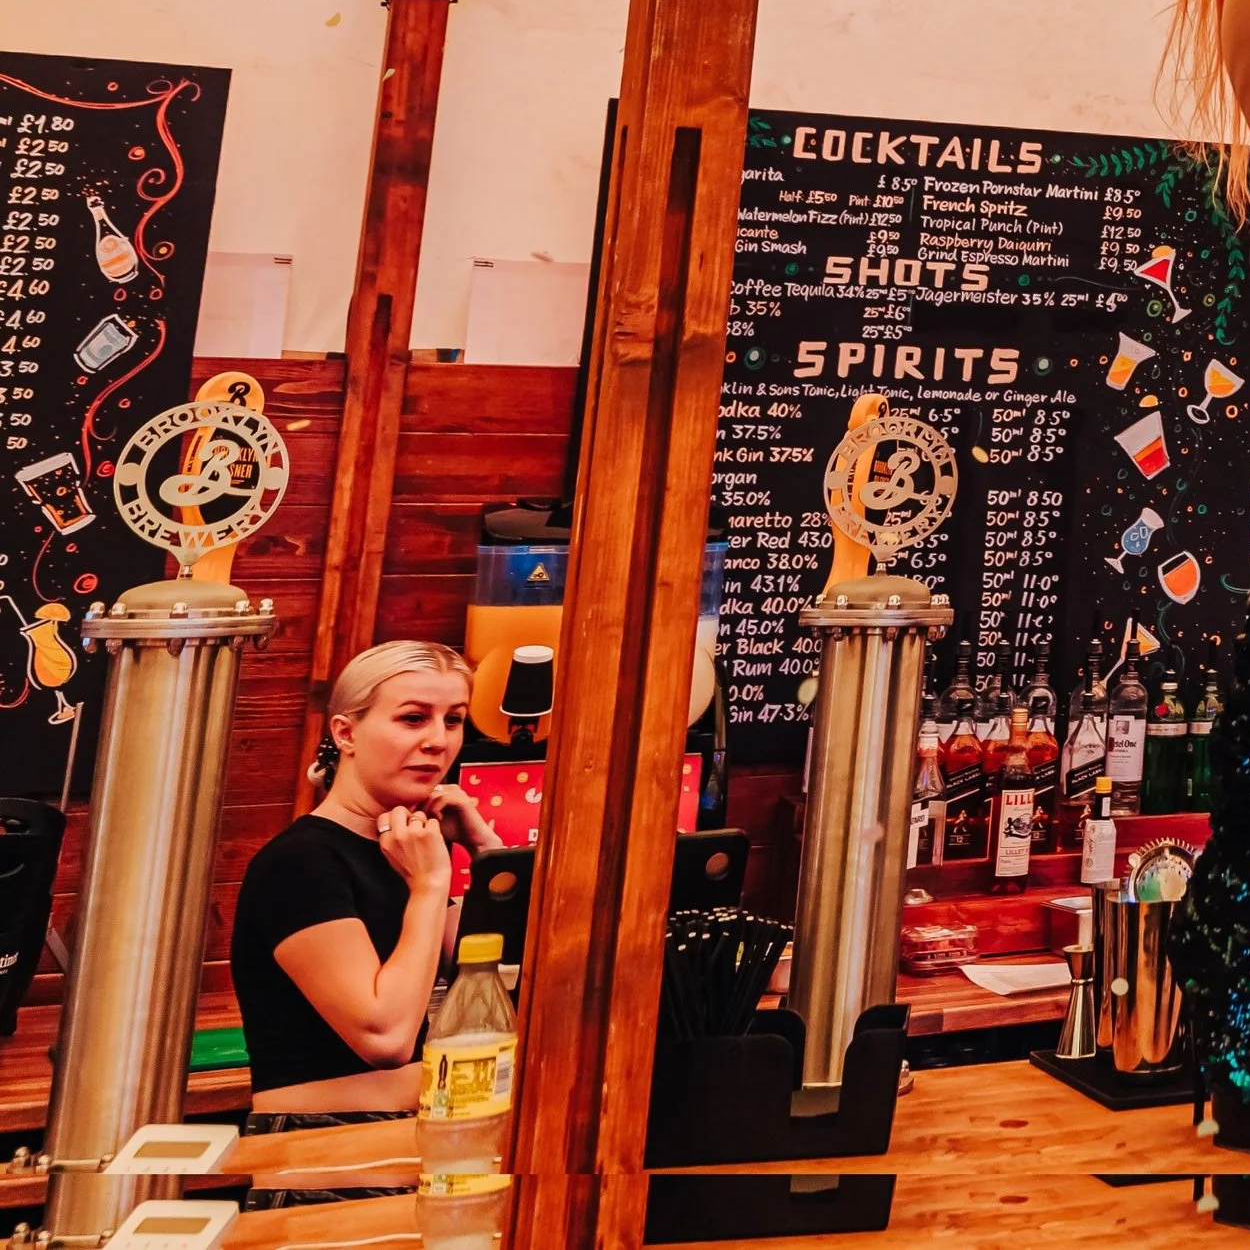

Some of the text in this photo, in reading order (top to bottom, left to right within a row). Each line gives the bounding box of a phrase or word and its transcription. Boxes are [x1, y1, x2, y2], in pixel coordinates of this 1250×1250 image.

[17, 114, 74, 134] £1.80
[793, 125, 1044, 173] COCKTAILS
[924, 176, 1098, 200] Frozen Pornstar Martini
[923, 195, 975, 212] French
[980, 201, 1027, 218] Spritz
[808, 210, 838, 224] Fizz
[920, 216, 1141, 239] Tropical Punch (Pint) £12.50
[734, 239, 758, 252] Gin
[762, 241, 806, 254] Smash
[919, 233, 995, 256] Raspberry
[917, 247, 957, 262] Grind
[961, 249, 1018, 267] Espresso
[1022, 252, 1068, 267] Martini
[822, 255, 990, 292] SHOTS
[730, 278, 781, 297] Coffee
[784, 281, 835, 301] Tequila
[914, 286, 1018, 306] Jagermeister
[1022, 292, 1055, 306] 35%
[746, 301, 781, 316] 35%
[794, 341, 1019, 386] SPIRITS
[756, 383, 766, 395] &
[771, 384, 800, 396] Sons
[802, 384, 839, 398] Tonic,
[918, 386, 982, 401] Lemonade
[985, 392, 999, 400] or
[1004, 390, 1047, 407] Ginger
[1051, 390, 1076, 403] Ale
[767, 403, 801, 418] 40%
[139, 405, 281, 457] BROOKLYN
[732, 425, 781, 440] 37.5%
[840, 420, 950, 464] BROOKLYN
[736, 447, 763, 462] Gin
[770, 447, 814, 462] 37.5%
[722, 491, 770, 506] 35.0%
[126, 500, 269, 549] BREWERY
[836, 502, 942, 547] BREERY
[757, 532, 790, 549] Red
[798, 531, 833, 548] 43.0
[767, 553, 818, 569] 38.0%
[751, 575, 801, 592] 43.1%
[736, 619, 784, 636] 45.0%
[736, 638, 784, 655] Black
[733, 660, 771, 676] Rum
[758, 703, 810, 722] 47.3%
